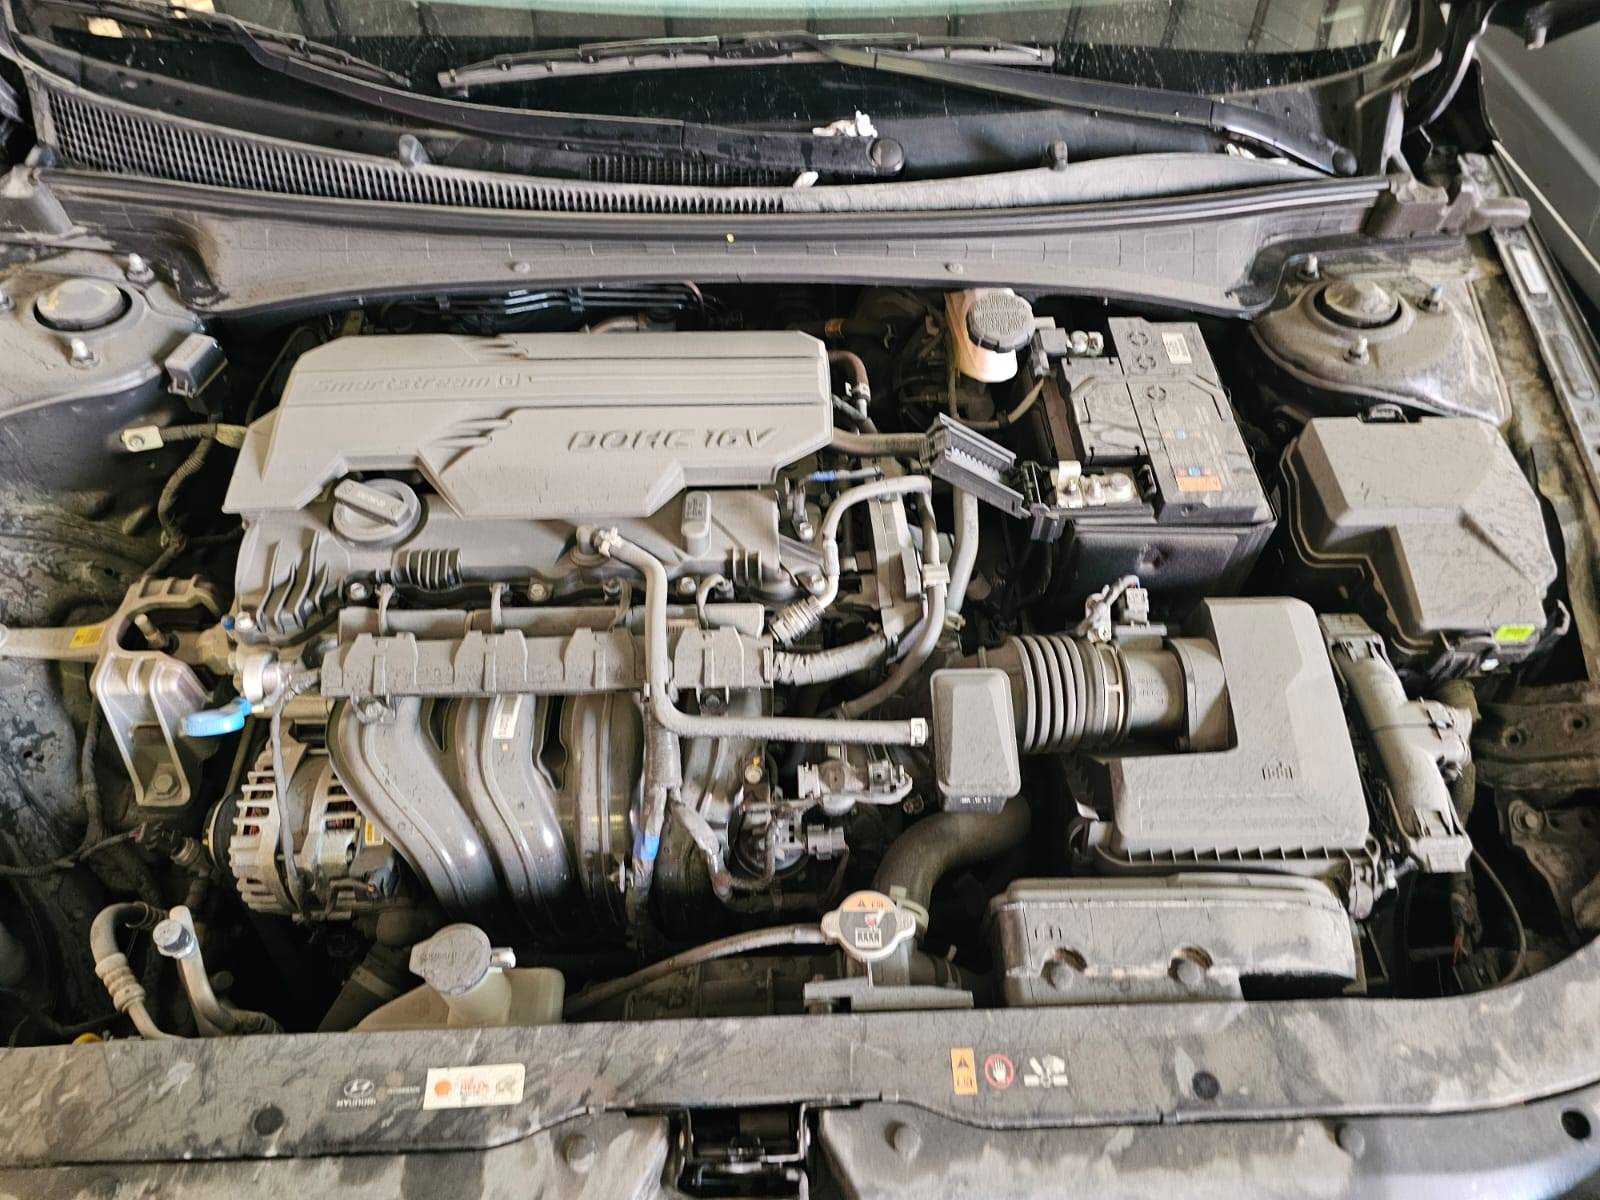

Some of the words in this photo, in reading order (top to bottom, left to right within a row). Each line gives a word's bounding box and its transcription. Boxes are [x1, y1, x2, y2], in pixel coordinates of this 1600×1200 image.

[312, 374, 491, 393] Smartstream
[567, 428, 697, 451] DOHC
[704, 427, 777, 449] 16V
